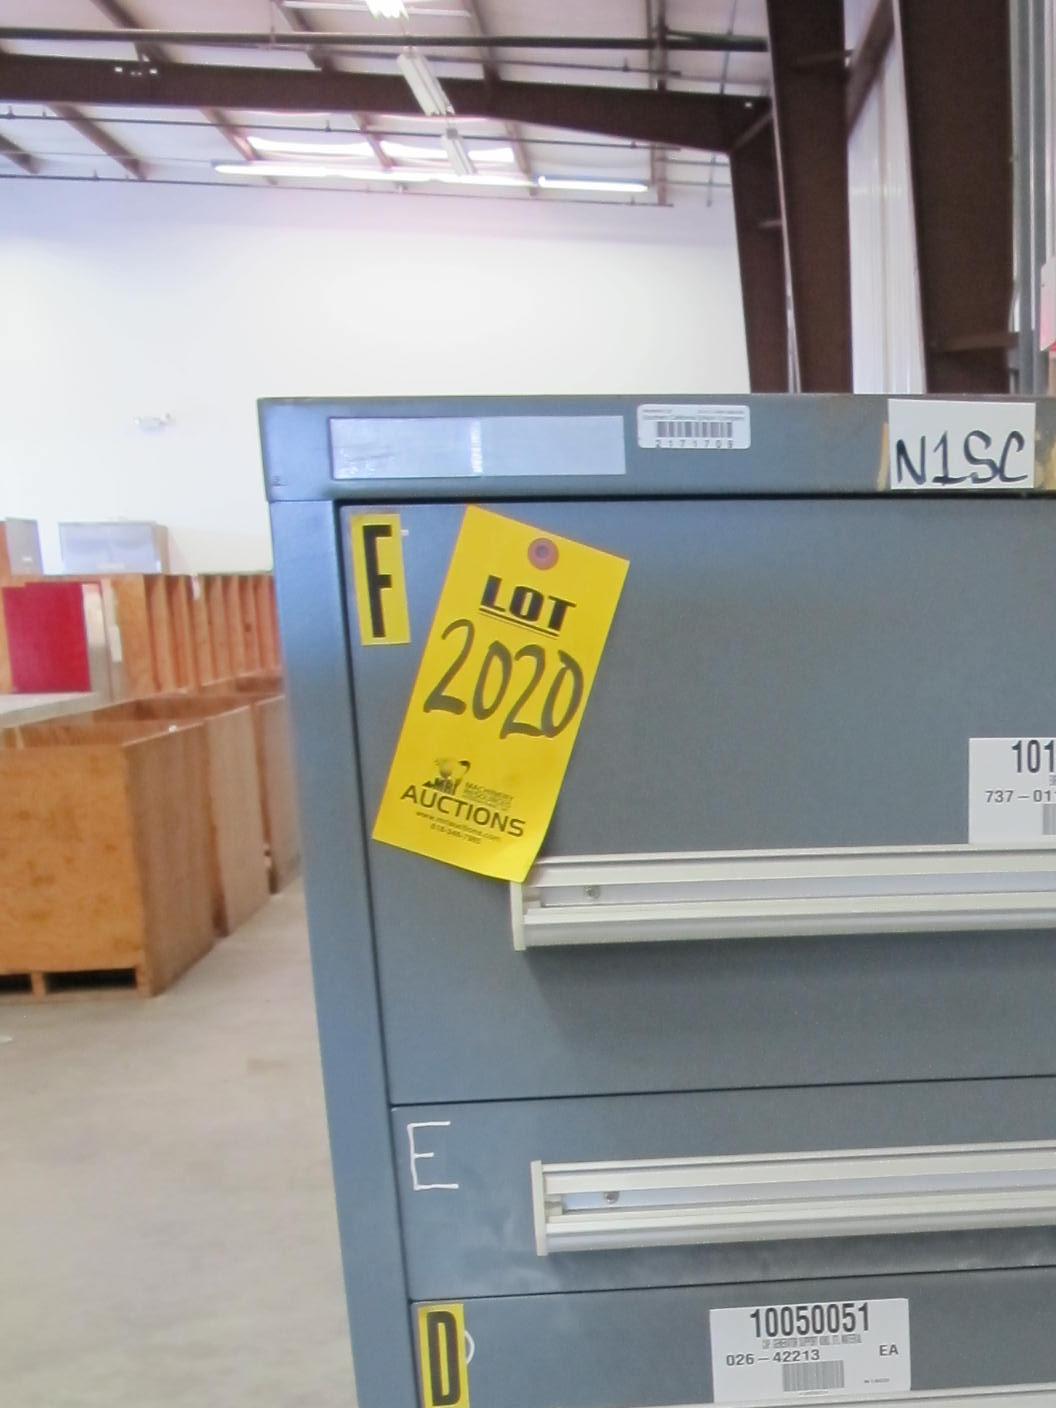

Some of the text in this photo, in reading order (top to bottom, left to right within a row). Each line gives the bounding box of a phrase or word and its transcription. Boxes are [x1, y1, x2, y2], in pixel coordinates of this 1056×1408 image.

[362, 524, 392, 638] F
[480, 575, 577, 632] LOT
[423, 619, 584, 739] 2020
[400, 784, 526, 838] AUCTIONS
[406, 1121, 459, 1192] E
[750, 1302, 869, 1338] 10050051
[879, 1344, 899, 1357] EA
[426, 1310, 460, 1407] D
